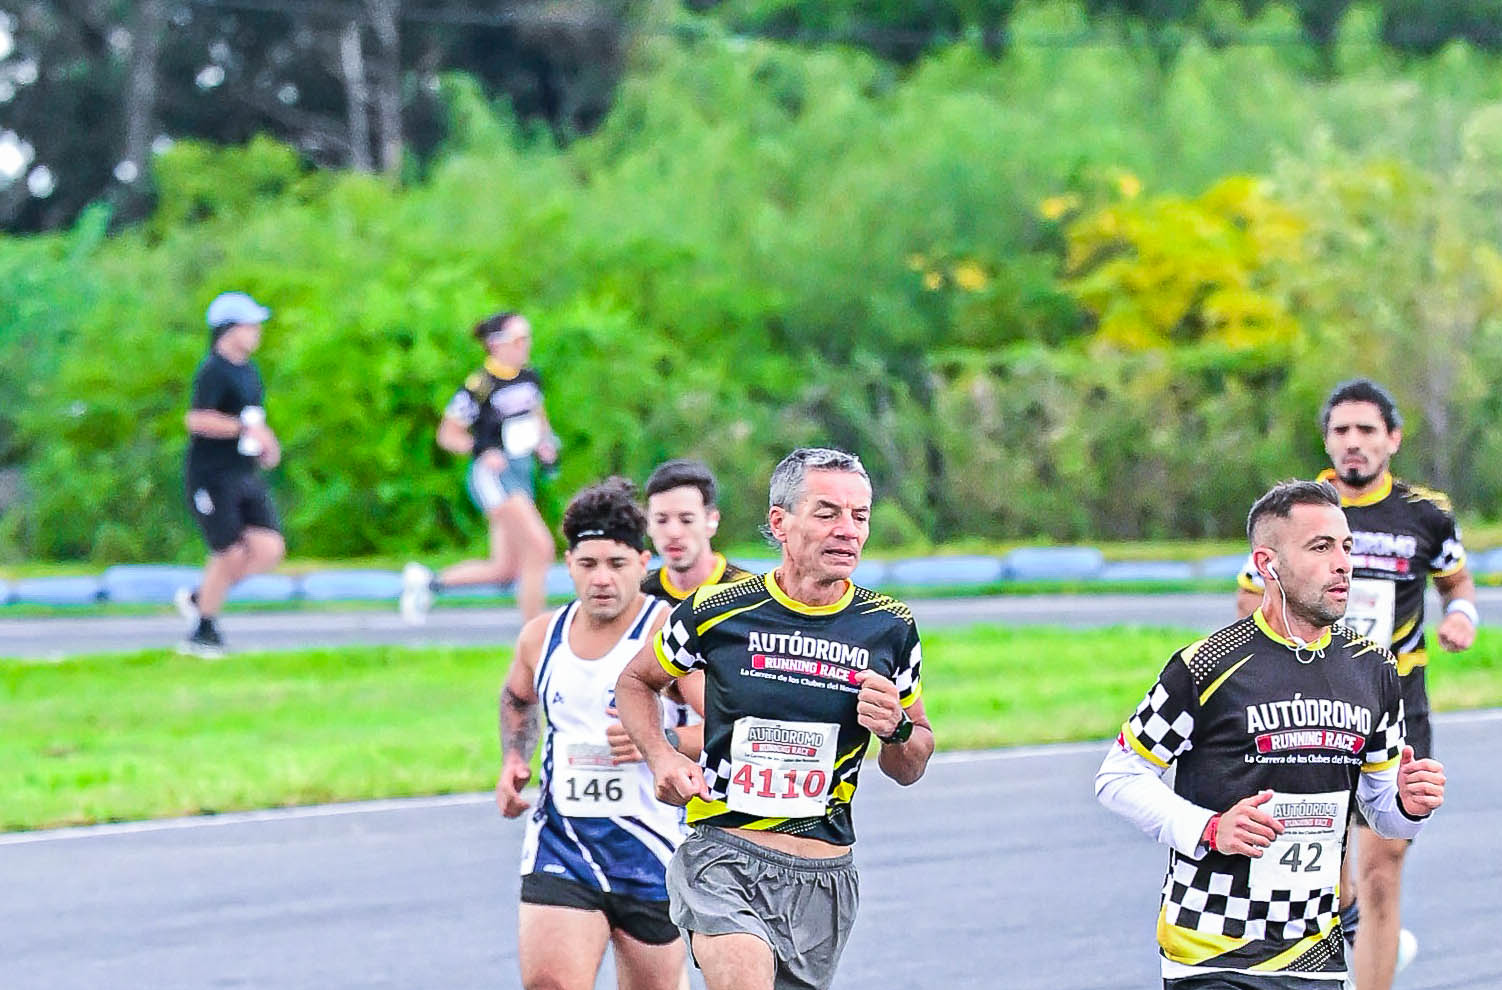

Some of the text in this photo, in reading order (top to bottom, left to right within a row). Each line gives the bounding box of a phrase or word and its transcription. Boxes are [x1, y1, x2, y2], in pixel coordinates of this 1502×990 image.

[747, 630, 870, 669] AUTÓDROMO
[765, 656, 851, 682] RUNNING RACE
[1246, 692, 1372, 735] AUTÓDROMO
[1271, 731, 1357, 751] RUNNING RACE
[565, 777, 624, 802] 146
[733, 764, 826, 799] 4110
[1279, 842, 1323, 873] 42
